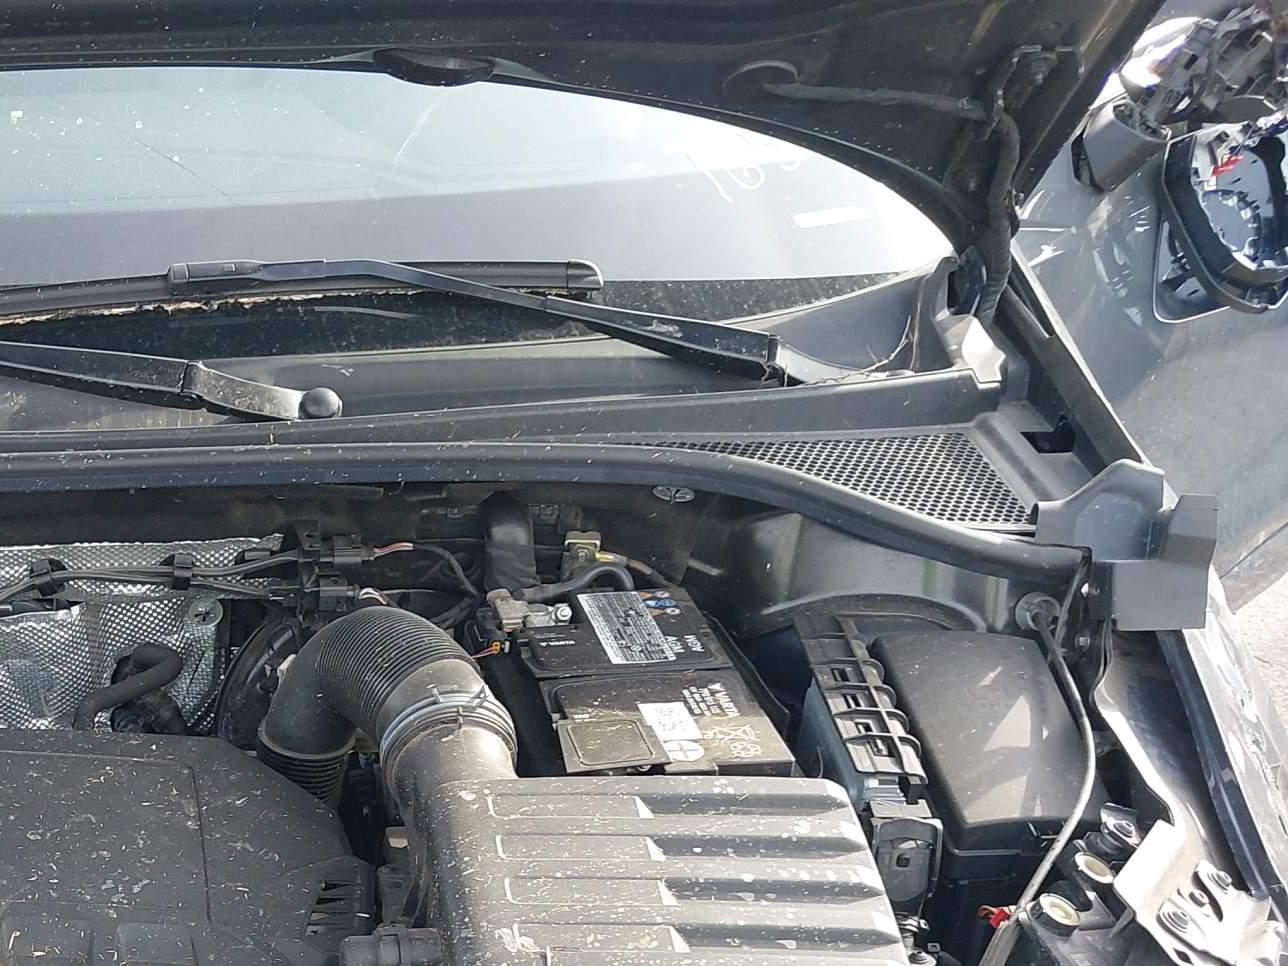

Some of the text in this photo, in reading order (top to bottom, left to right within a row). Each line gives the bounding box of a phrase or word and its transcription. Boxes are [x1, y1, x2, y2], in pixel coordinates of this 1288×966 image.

[665, 635, 685, 653] AGM
[683, 634, 705, 652] AGM
[715, 691, 741, 719] VARTA
